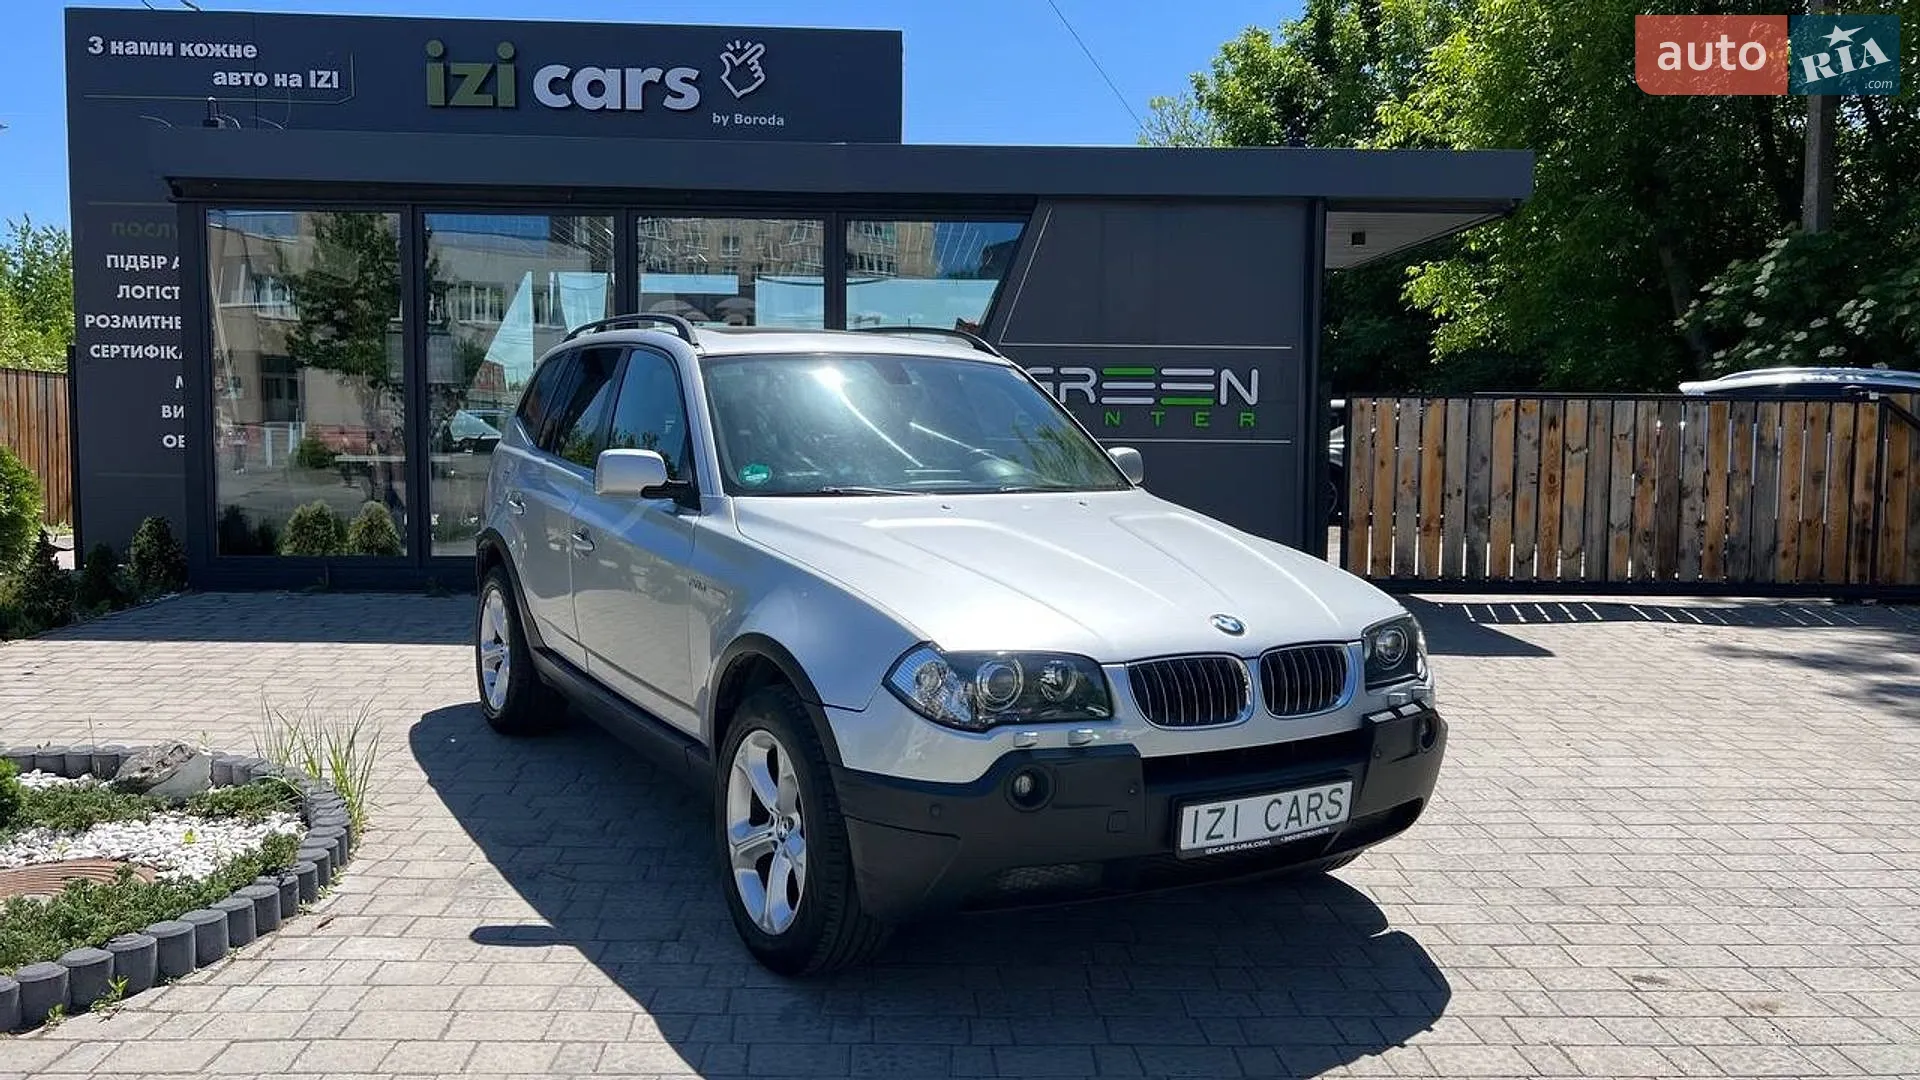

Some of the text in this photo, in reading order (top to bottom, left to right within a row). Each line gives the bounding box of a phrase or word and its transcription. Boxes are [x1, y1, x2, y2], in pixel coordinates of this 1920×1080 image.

[88, 36, 257, 58] З нами кожне
[213, 70, 339, 88] авто на IZI
[425, 39, 701, 110] izi cars
[712, 112, 784, 126] by Boroda
[106, 254, 168, 271] ПІДБІР
[117, 285, 180, 299] ЛОГІСТ
[90, 344, 183, 360] СЕРТИФІК
[1192, 787, 1343, 844] IZI CARS
